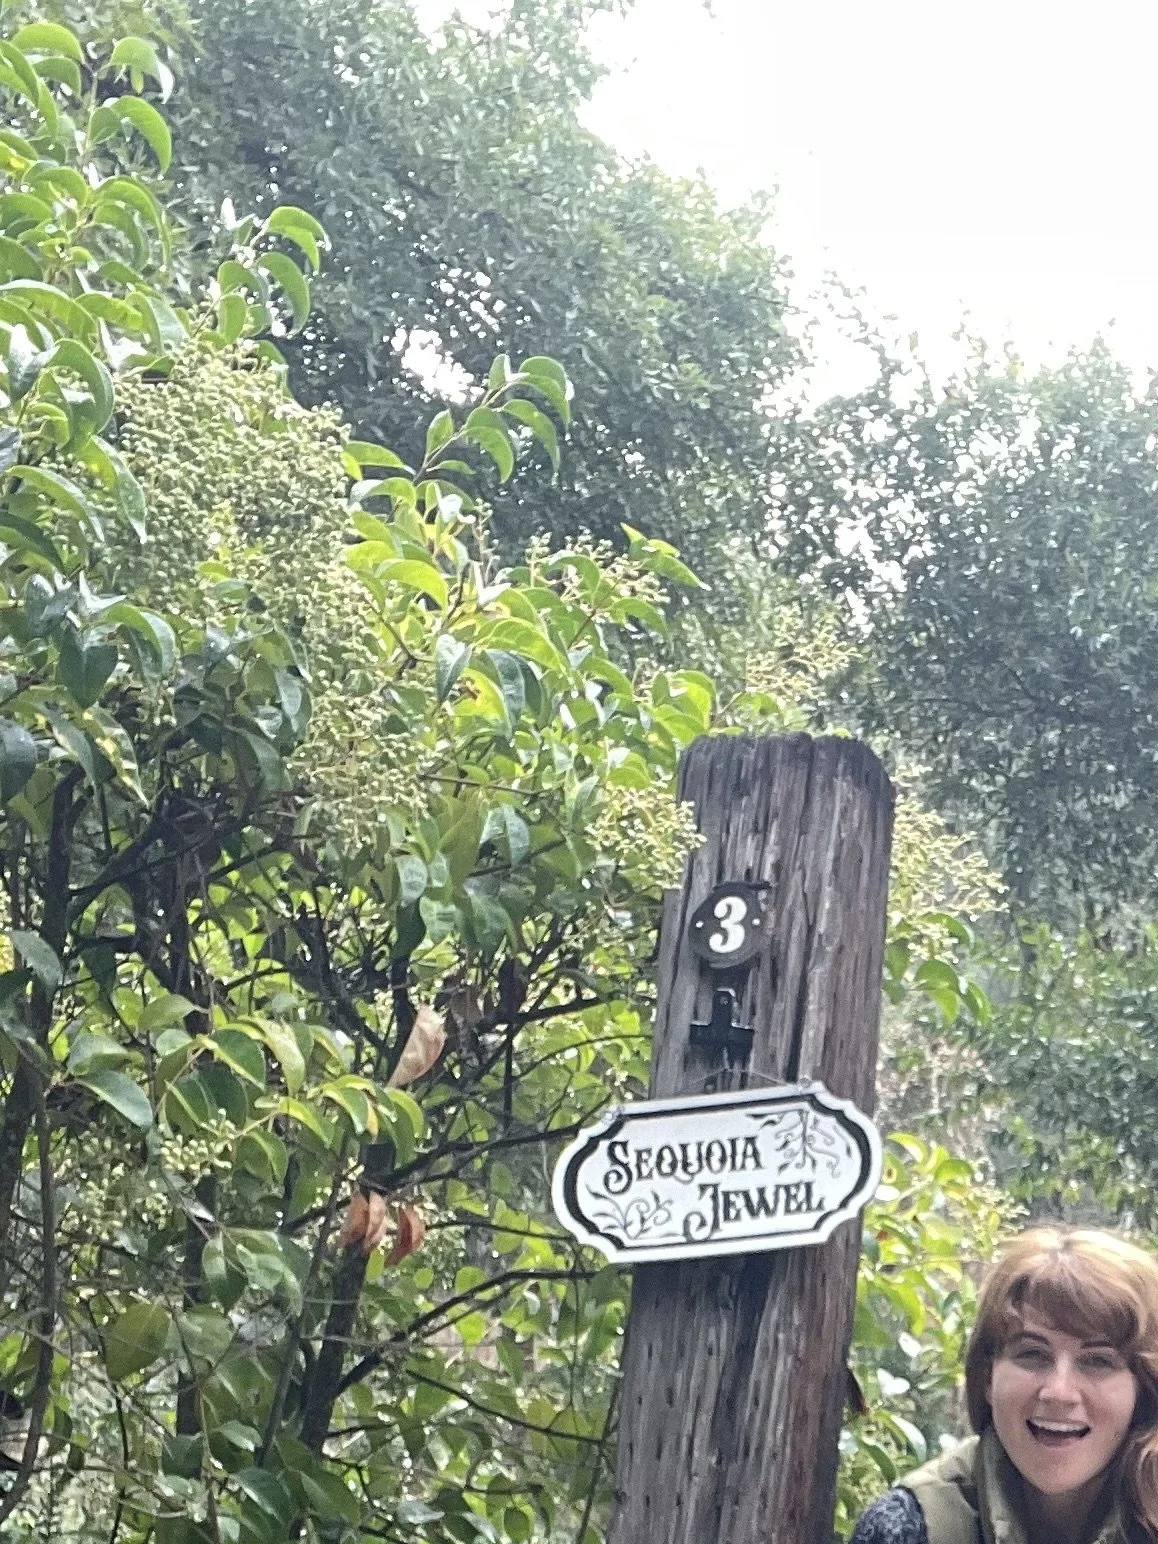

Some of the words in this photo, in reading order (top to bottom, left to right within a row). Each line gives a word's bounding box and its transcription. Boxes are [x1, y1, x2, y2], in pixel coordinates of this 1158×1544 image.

[709, 896, 748, 953] 3
[604, 1136, 764, 1194] SEQUOIA
[683, 1181, 826, 1243] JEWEL
